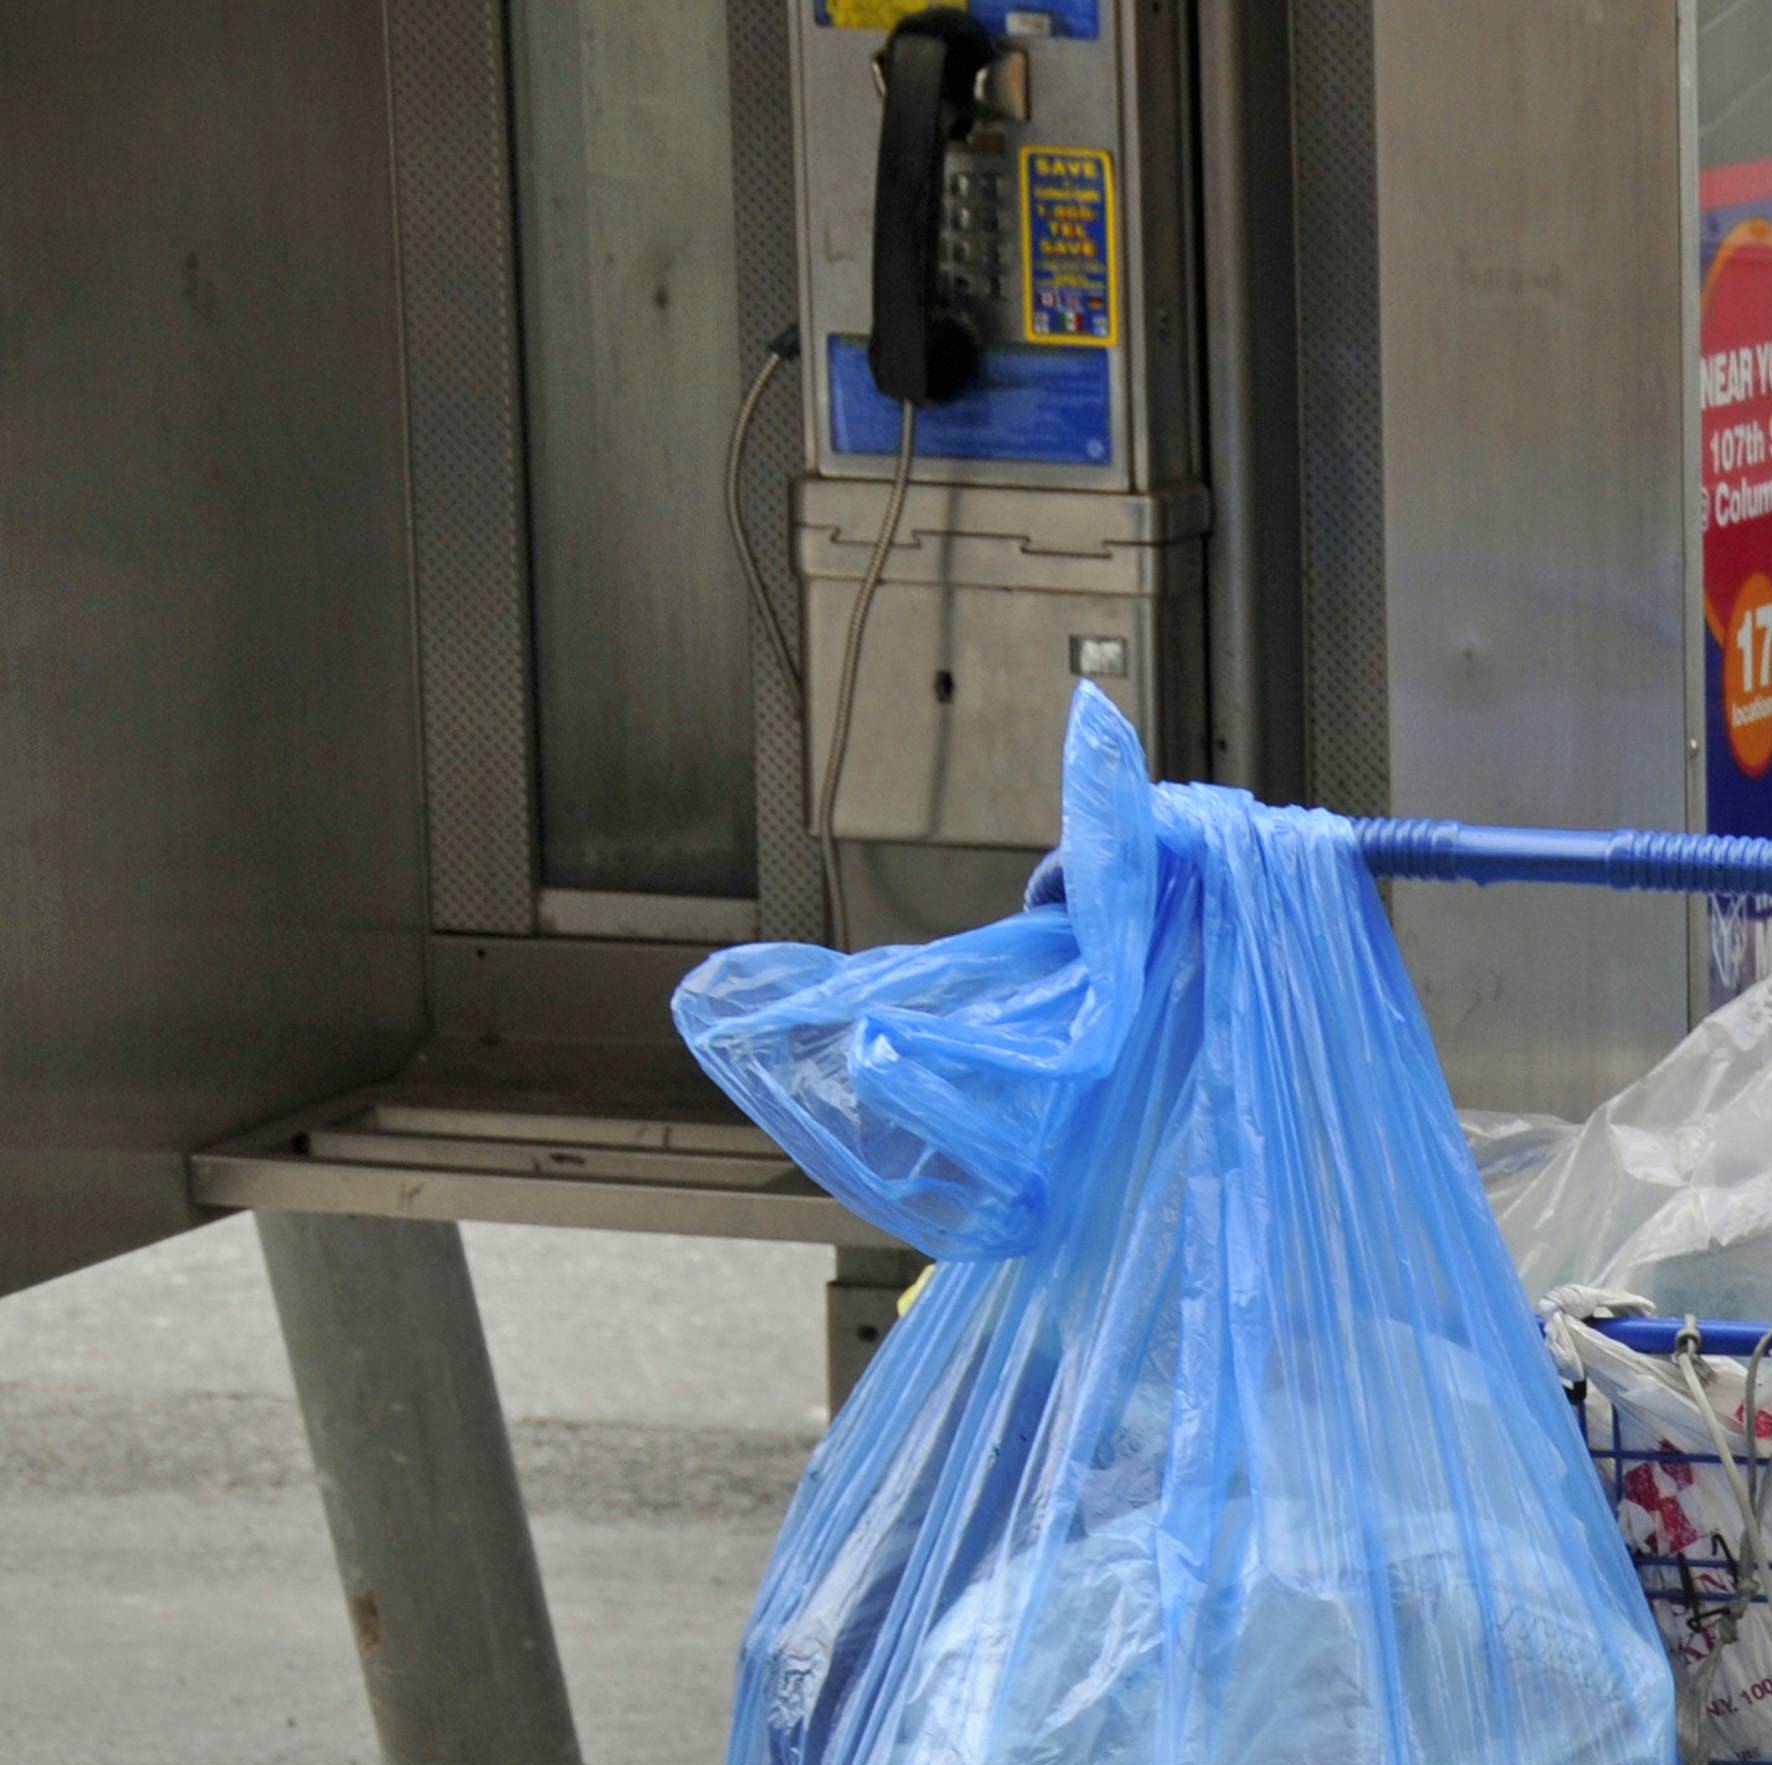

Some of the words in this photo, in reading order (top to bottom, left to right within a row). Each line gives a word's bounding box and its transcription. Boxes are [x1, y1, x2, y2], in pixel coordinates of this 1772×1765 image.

[1034, 158, 1097, 178] SAVE
[1701, 345, 1754, 411] NEAR
[1710, 418, 1766, 476] 107th
